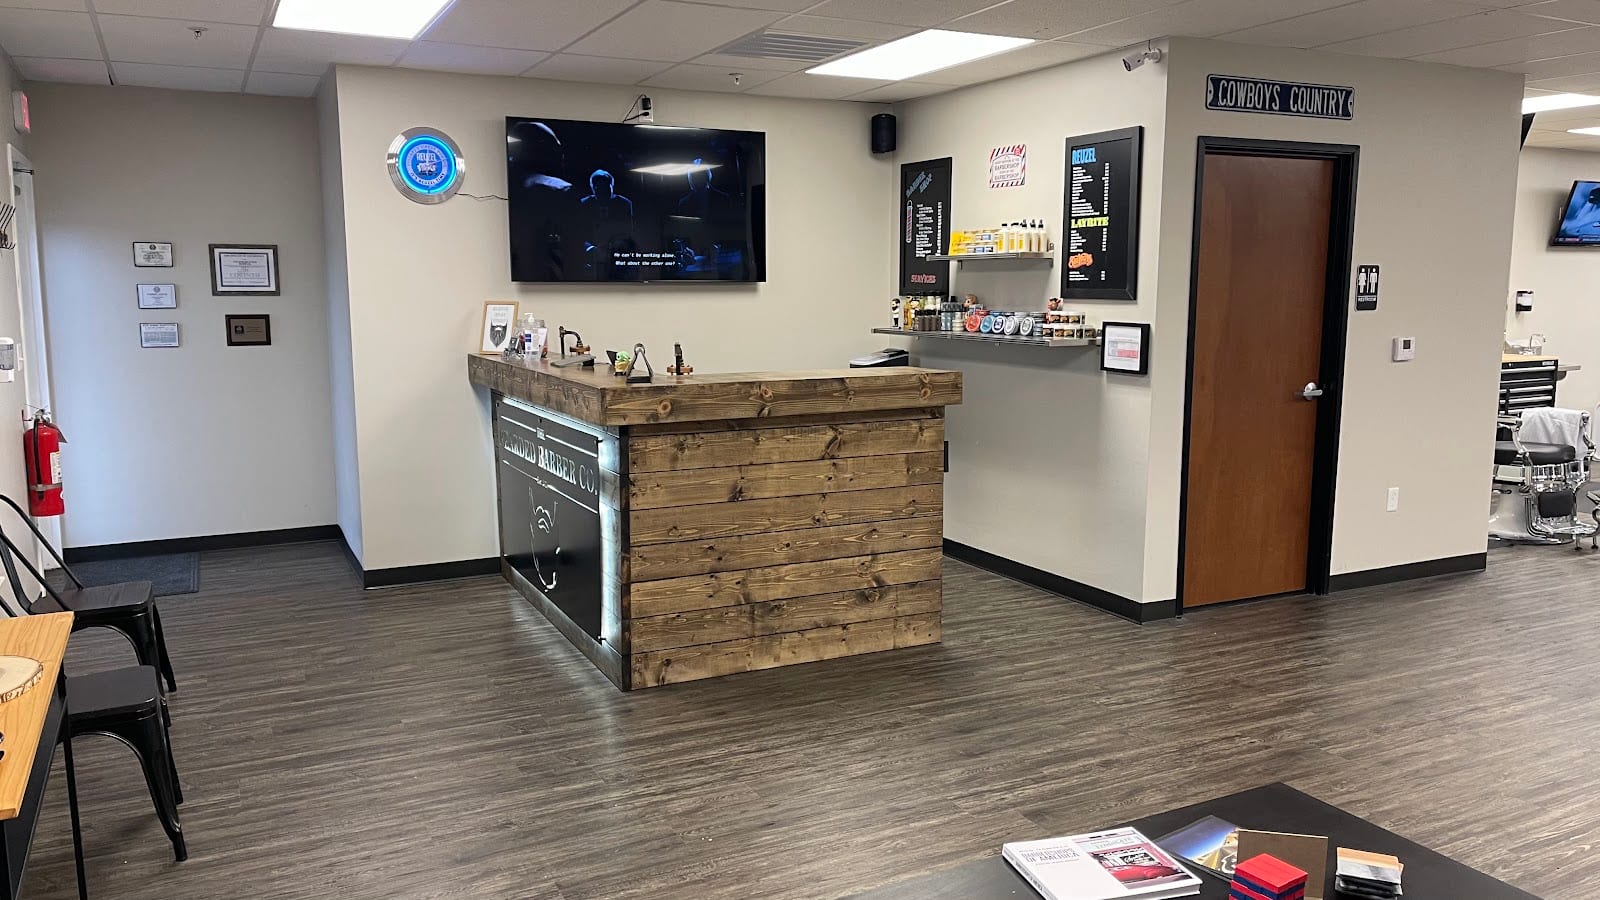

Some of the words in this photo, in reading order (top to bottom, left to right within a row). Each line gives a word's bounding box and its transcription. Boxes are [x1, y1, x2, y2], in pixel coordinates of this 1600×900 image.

[1218, 79, 1281, 111] COWBOYS
[1289, 85, 1346, 116] COUNTRY
[1072, 147, 1096, 165] REUZEL
[538, 445, 576, 485] BARBER
[579, 464, 598, 496] CO.
